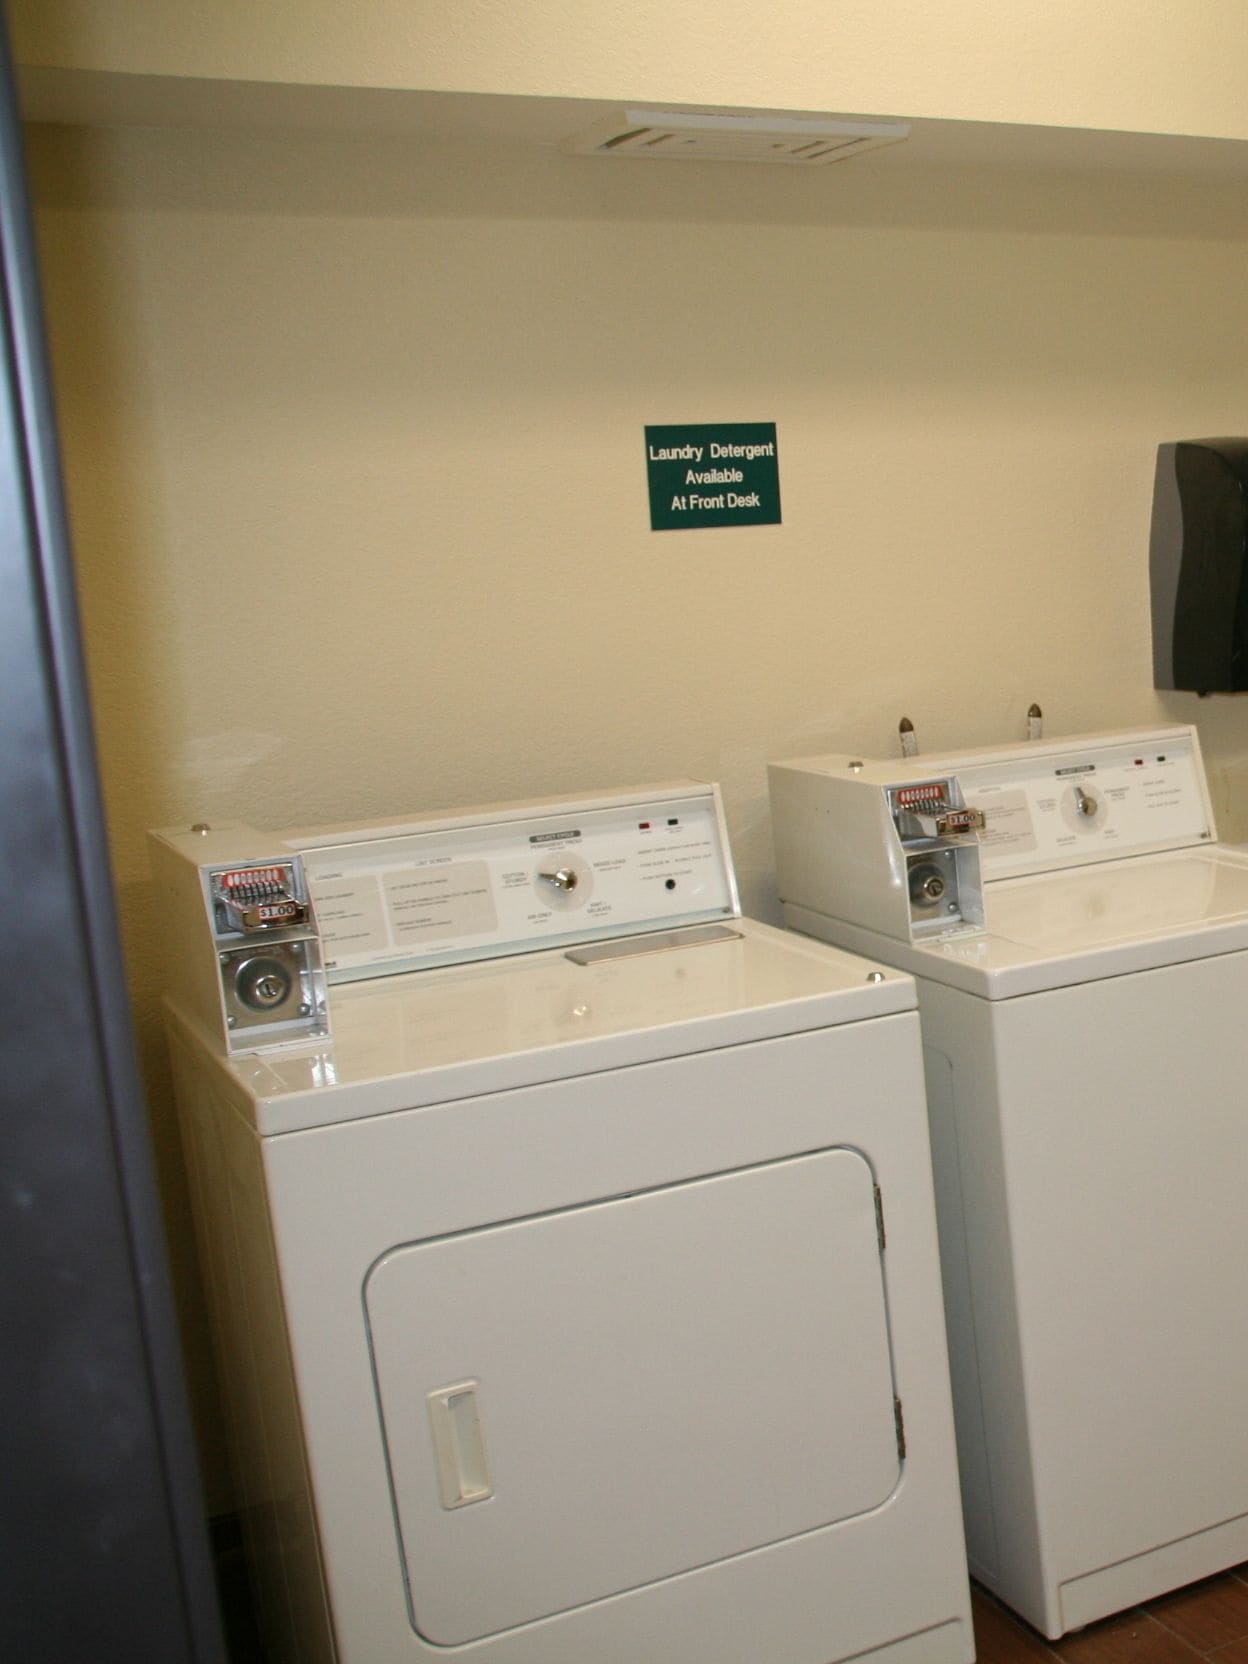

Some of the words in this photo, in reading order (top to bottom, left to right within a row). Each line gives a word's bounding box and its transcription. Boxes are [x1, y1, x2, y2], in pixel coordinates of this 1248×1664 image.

[649, 444, 703, 462] Laundry
[710, 442, 774, 460] Detergent
[685, 468, 743, 485] Available
[671, 496, 686, 511] At
[690, 494, 725, 510] Front
[728, 492, 760, 507] Desk
[950, 814, 976, 825] $1.00
[260, 906, 294, 917] $1.00
